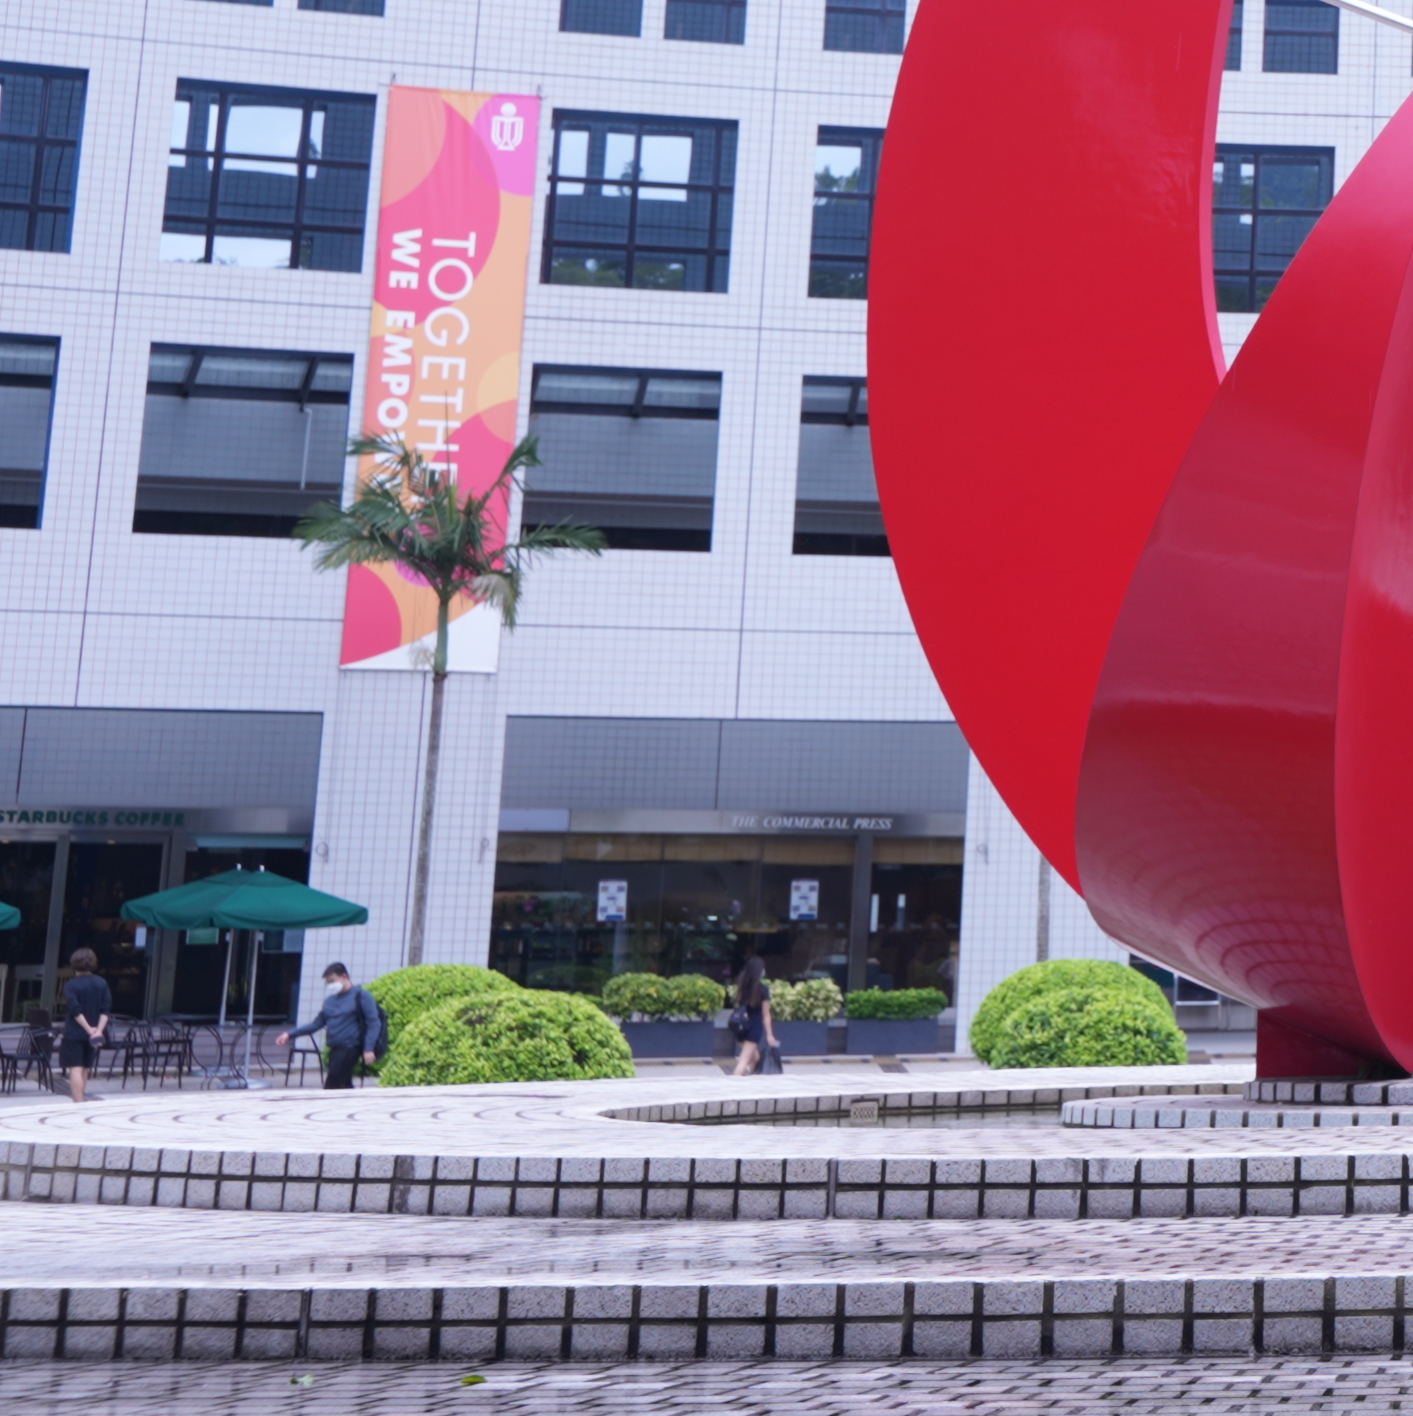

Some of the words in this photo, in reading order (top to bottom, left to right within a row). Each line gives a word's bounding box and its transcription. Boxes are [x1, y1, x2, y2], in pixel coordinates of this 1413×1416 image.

[388, 229, 423, 290] WE
[114, 811, 185, 826] COFFEE
[731, 815, 759, 827] THE
[763, 815, 850, 829] COMMERCIAL
[853, 817, 895, 830] PRESS
